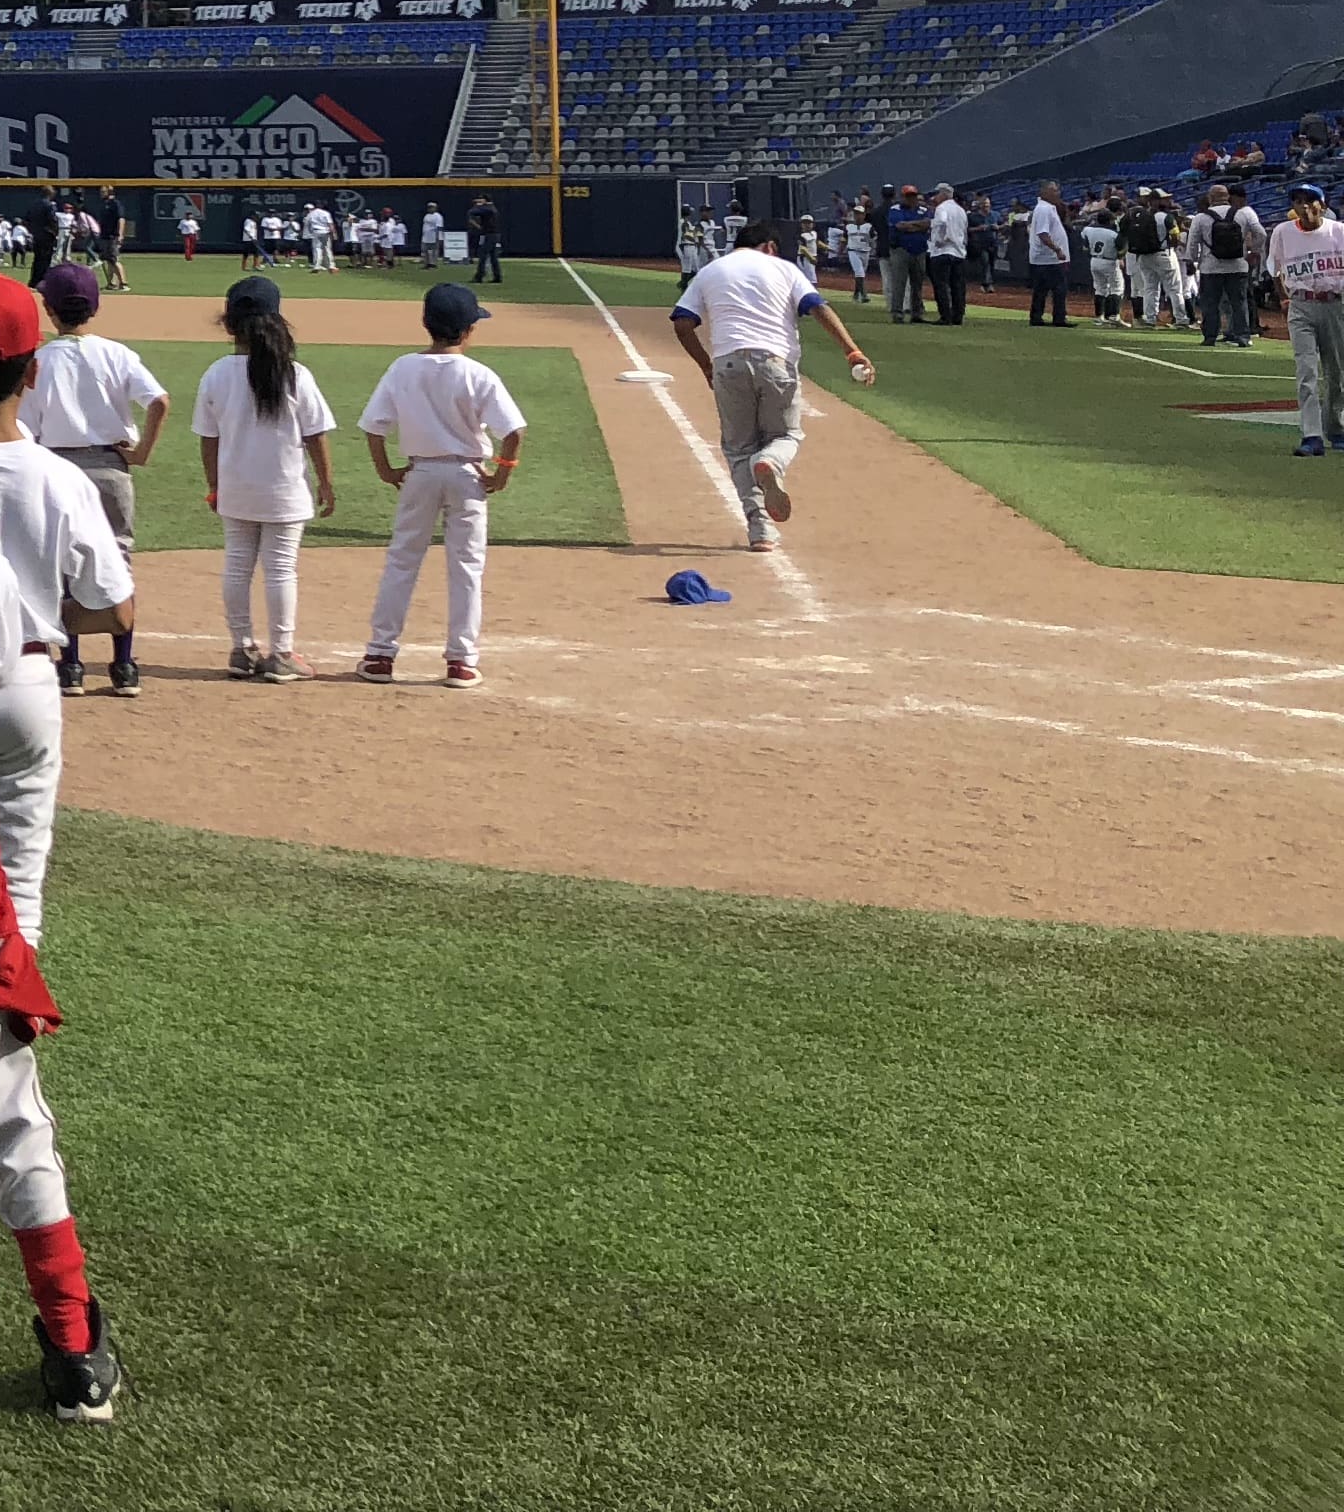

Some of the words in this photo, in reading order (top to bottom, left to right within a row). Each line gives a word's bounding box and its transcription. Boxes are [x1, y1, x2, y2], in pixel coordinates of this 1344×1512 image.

[151, 116, 227, 126] MONTERREY
[152, 127, 317, 156] MEXICO
[153, 158, 318, 180] SERIES
[563, 187, 591, 198] 325
[1286, 260, 1314, 278] PLAY
[1316, 256, 1344, 272] BALL
